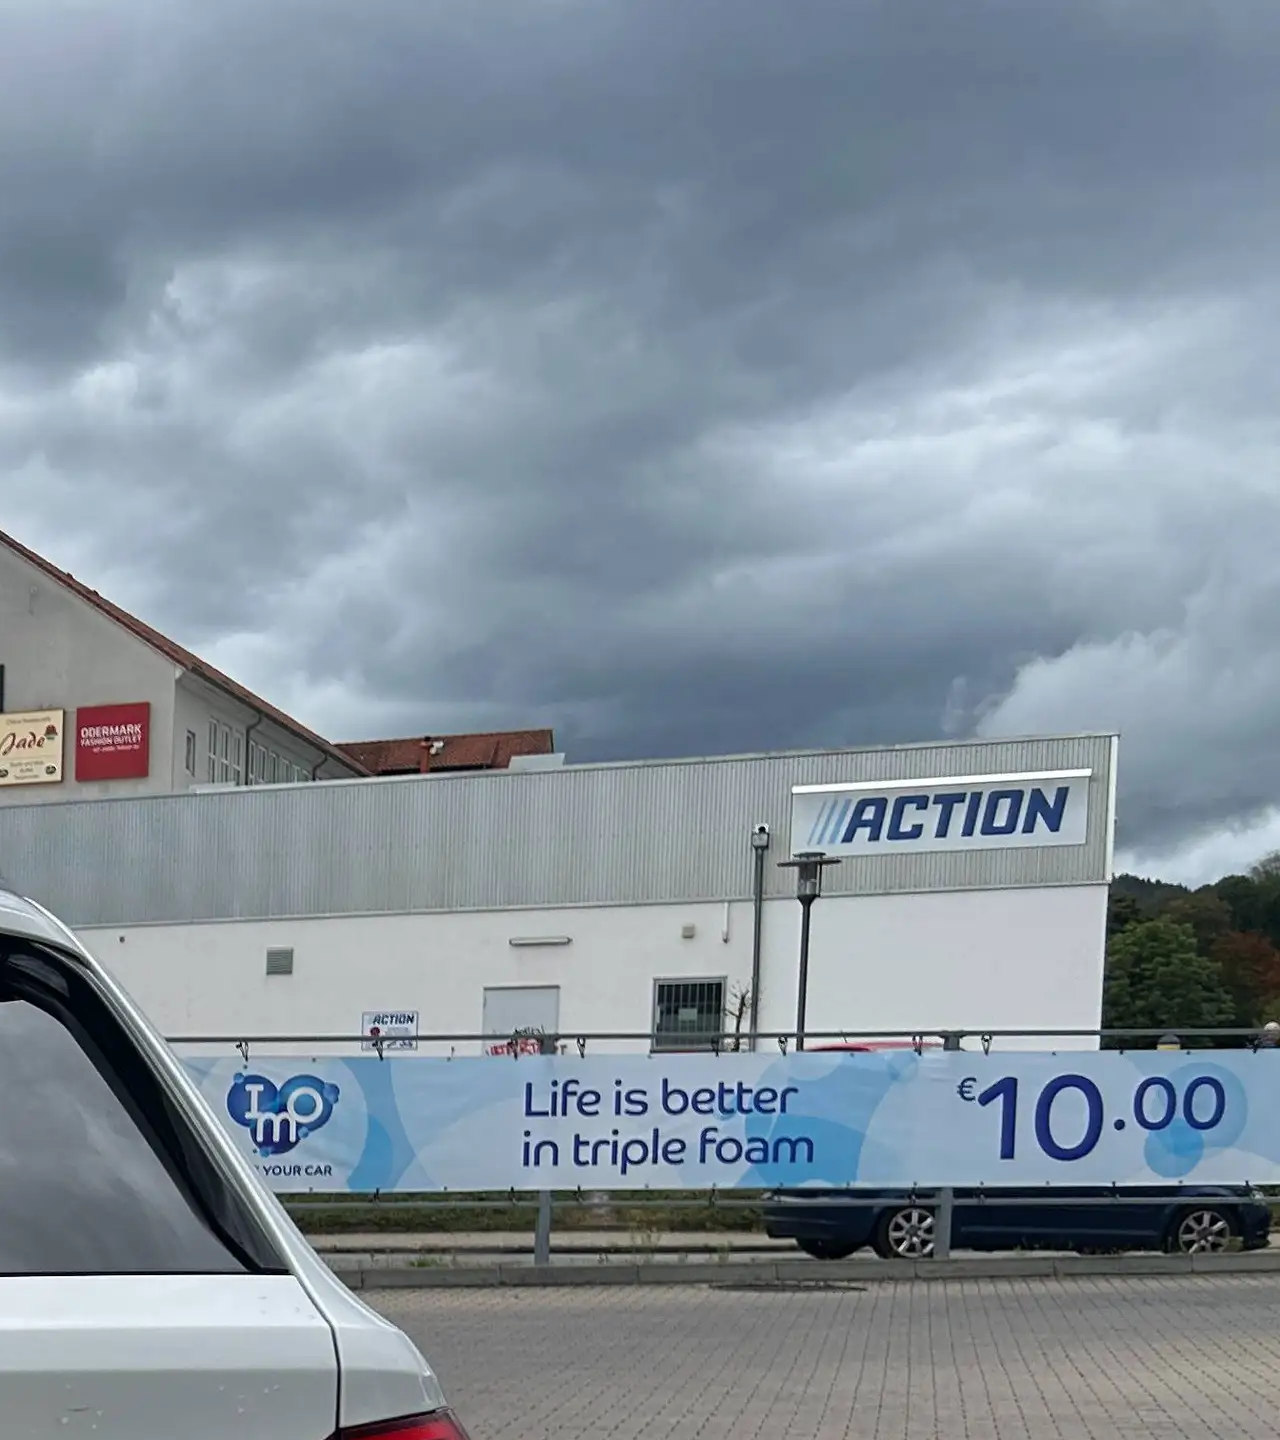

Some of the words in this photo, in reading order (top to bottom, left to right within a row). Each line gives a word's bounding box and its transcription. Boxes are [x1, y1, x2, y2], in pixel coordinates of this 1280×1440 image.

[81, 724, 142, 738] ODERMARK
[80, 737, 113, 747] FASHION
[114, 734, 142, 745] OUTLET
[840, 786, 1070, 843] ACTION
[372, 1013, 415, 1026] ACTION
[524, 1079, 601, 1117] Life
[614, 1079, 648, 1116] is
[661, 1078, 799, 1116] better
[522, 1129, 559, 1167] in
[573, 1127, 687, 1175] triple
[699, 1127, 814, 1164] foam
[262, 1165, 301, 1176] YOUR
[304, 1165, 332, 1176] CAR
